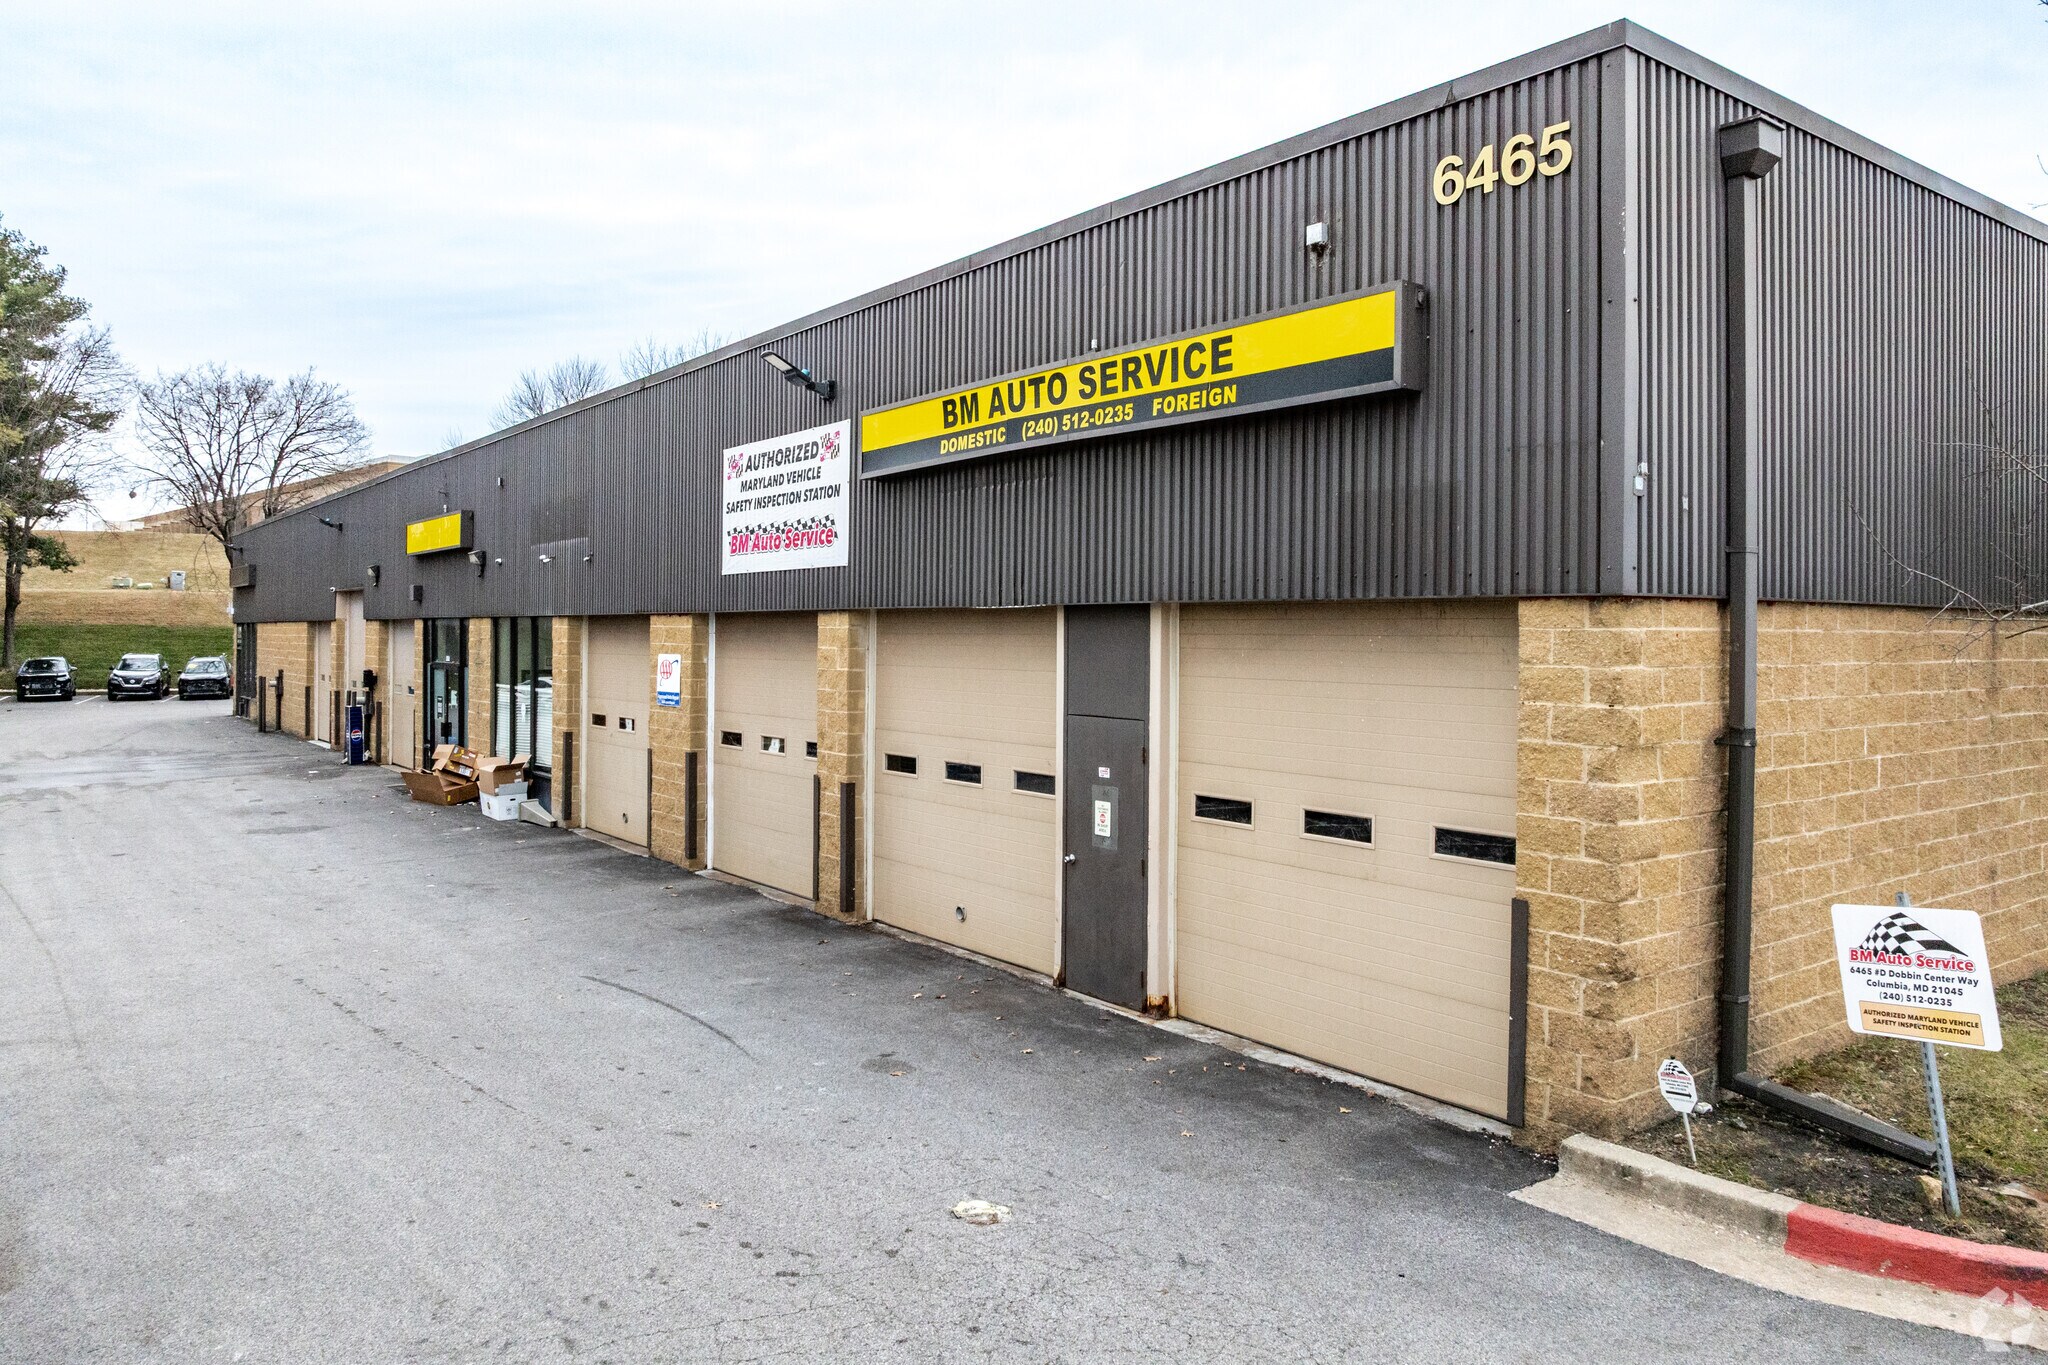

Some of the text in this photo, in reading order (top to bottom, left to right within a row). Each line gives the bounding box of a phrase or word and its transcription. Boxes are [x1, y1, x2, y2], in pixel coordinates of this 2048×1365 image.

[1433, 121, 1573, 206] 6465
[942, 334, 1234, 429] BM AUTO SERVICE
[940, 384, 1237, 454] DOMESTIC (240) 512-0235 FOREIGN
[744, 440, 820, 473] AUTHORIZED
[740, 466, 822, 493] MARYLAND VEHICLE
[726, 483, 841, 515] SAFETY INSPECTION STATION
[730, 522, 834, 555] BM Auto Service
[1850, 949, 1974, 972] BM Auto Service
[1850, 966, 1979, 987] 6465 #D Dobbin Center Way
[1866, 979, 1964, 996] Columbia, MD 21045
[1879, 991, 1953, 1007] (240) 512-0235
[1863, 1008, 1979, 1029] AUTHORIZED MARYLAND VEHICLE
[1872, 1017, 1971, 1036] SAFETY INSPECTION STATION
